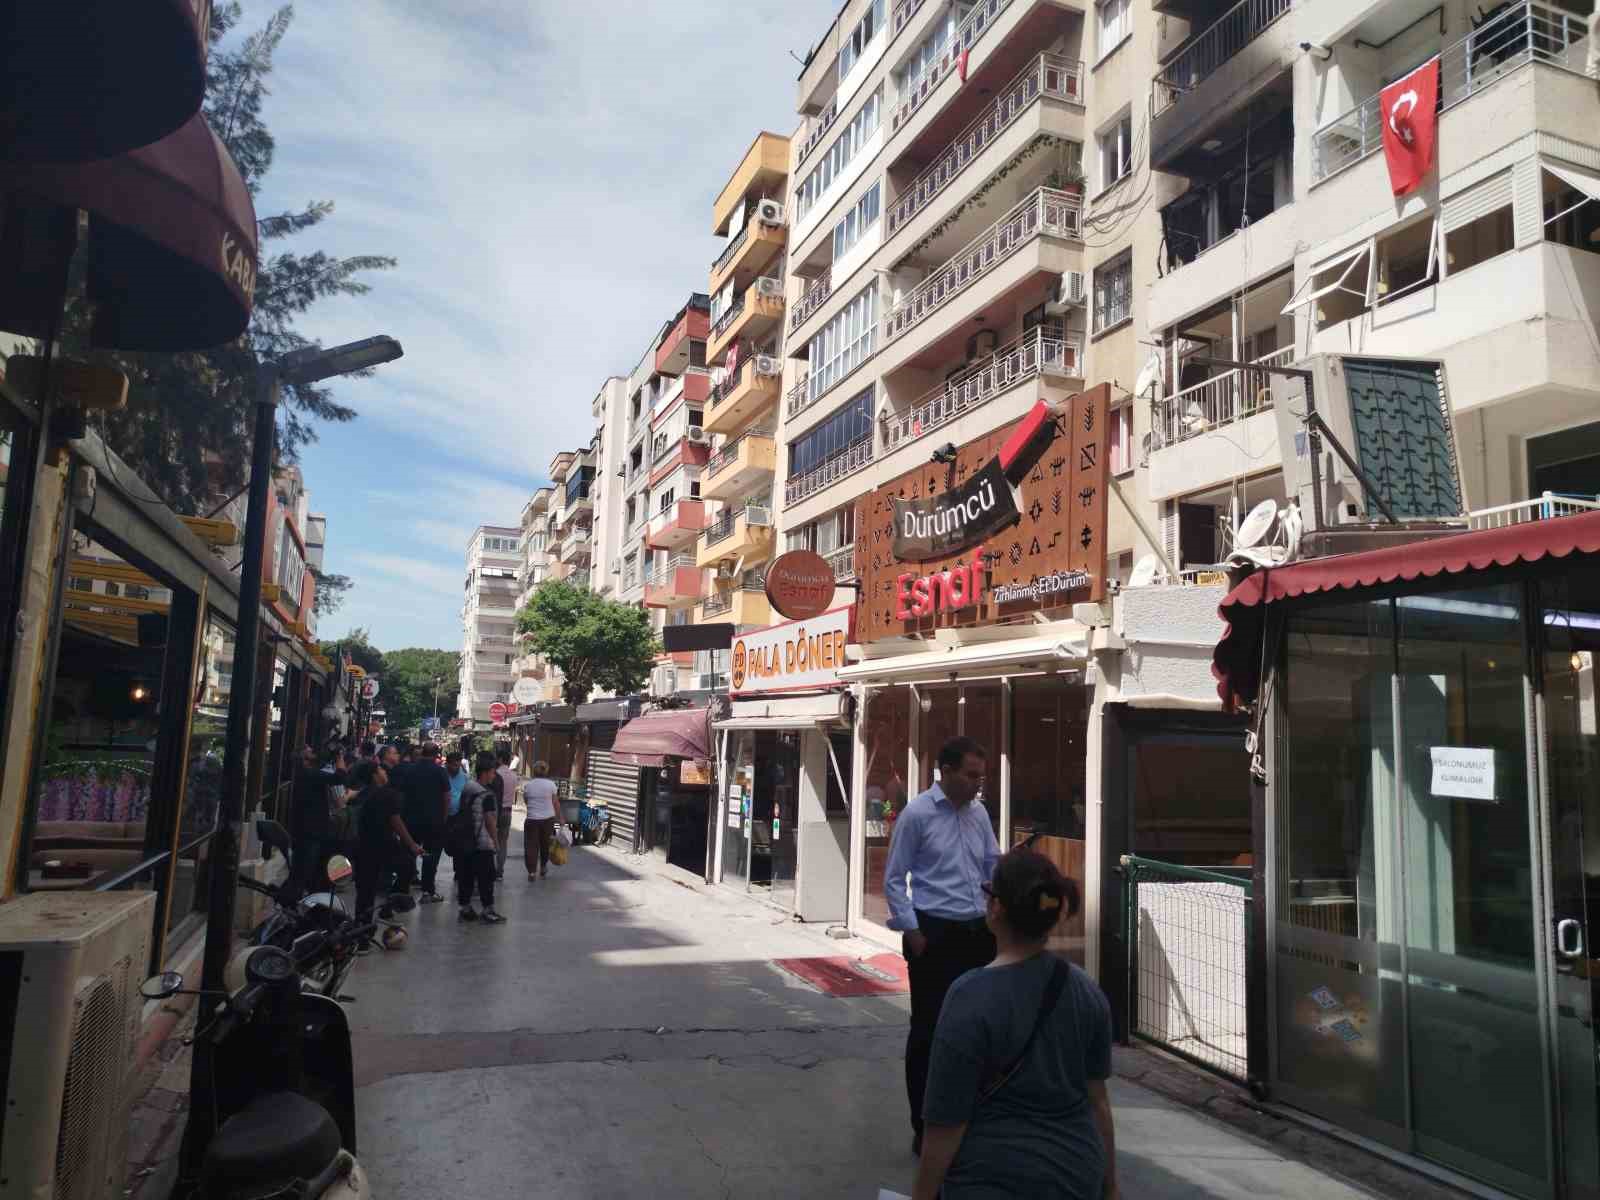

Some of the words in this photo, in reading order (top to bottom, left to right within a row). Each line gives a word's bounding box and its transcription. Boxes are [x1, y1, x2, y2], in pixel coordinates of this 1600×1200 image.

[903, 478, 996, 539] Dürümcü
[896, 545, 984, 621] Esnaf
[1039, 577, 1050, 594] Et
[748, 643, 782, 679] PALA
[785, 627, 846, 673] DÖNER
